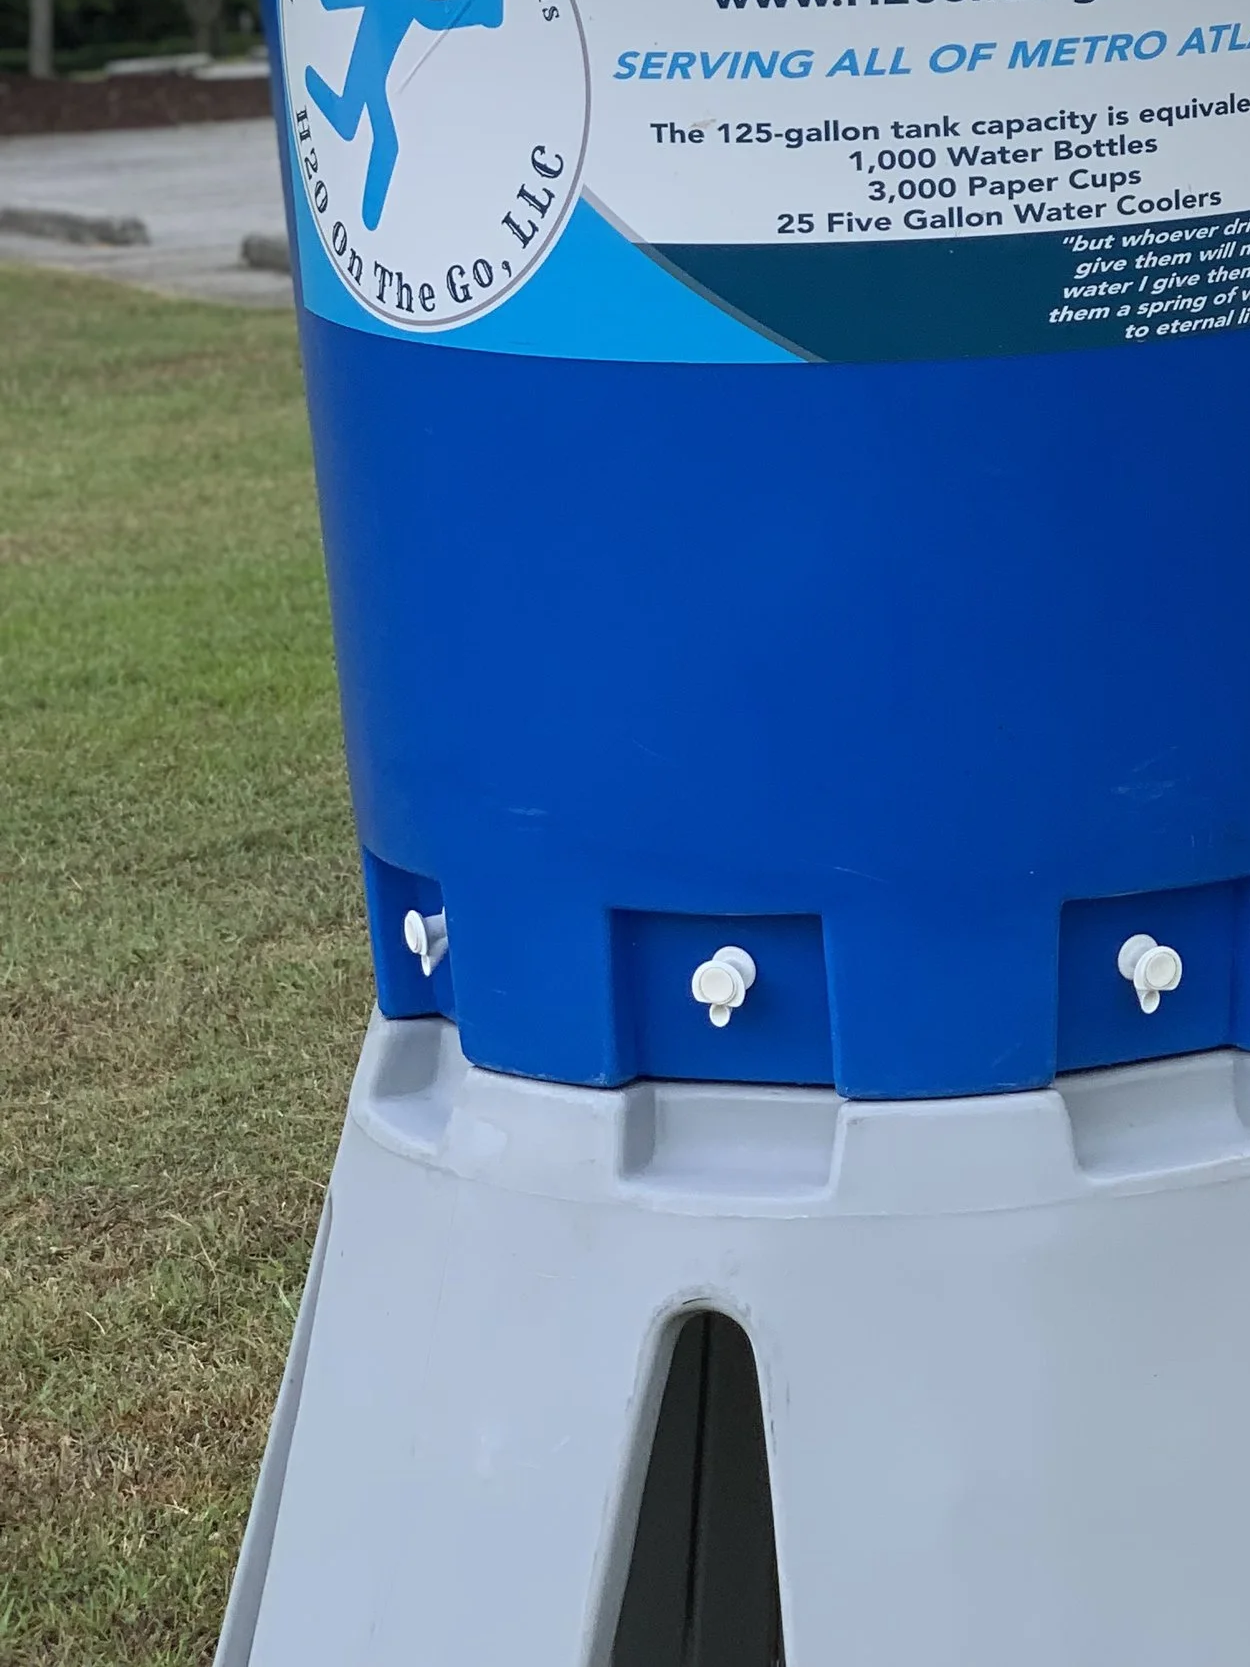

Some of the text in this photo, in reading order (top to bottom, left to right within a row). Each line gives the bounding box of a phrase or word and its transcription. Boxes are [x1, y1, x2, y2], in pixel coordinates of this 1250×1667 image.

[612, 49, 815, 79] SERVING
[826, 47, 910, 78] ALL
[929, 42, 997, 73] OF
[1007, 29, 1167, 71] METRO
[650, 121, 705, 146] The
[717, 117, 880, 150] 125-gallon
[890, 115, 960, 139] tank
[971, 108, 1098, 140] capacity
[1107, 106, 1130, 127] is
[849, 133, 1158, 176] 1,000 Water Bottles
[867, 165, 1143, 205] 3,000 Paper Cups
[331, 220, 365, 287] On
[373, 261, 436, 314] The
[446, 256, 514, 304] Go,
[501, 144, 564, 250] LLC
[777, 186, 1223, 236] 25 Five Gallon Water Coolers
[1121, 224, 1219, 248] whoever
[1074, 258, 1127, 280] give
[1134, 251, 1192, 270] them
[1199, 241, 1235, 262] will
[1049, 308, 1110, 324] them
[1116, 306, 1131, 317] a
[1136, 294, 1207, 319] spring
[1213, 289, 1239, 306] of
[1063, 281, 1134, 299] water
[1152, 274, 1201, 294] give
[1125, 324, 1149, 340] to
[1156, 315, 1233, 335] eternal
